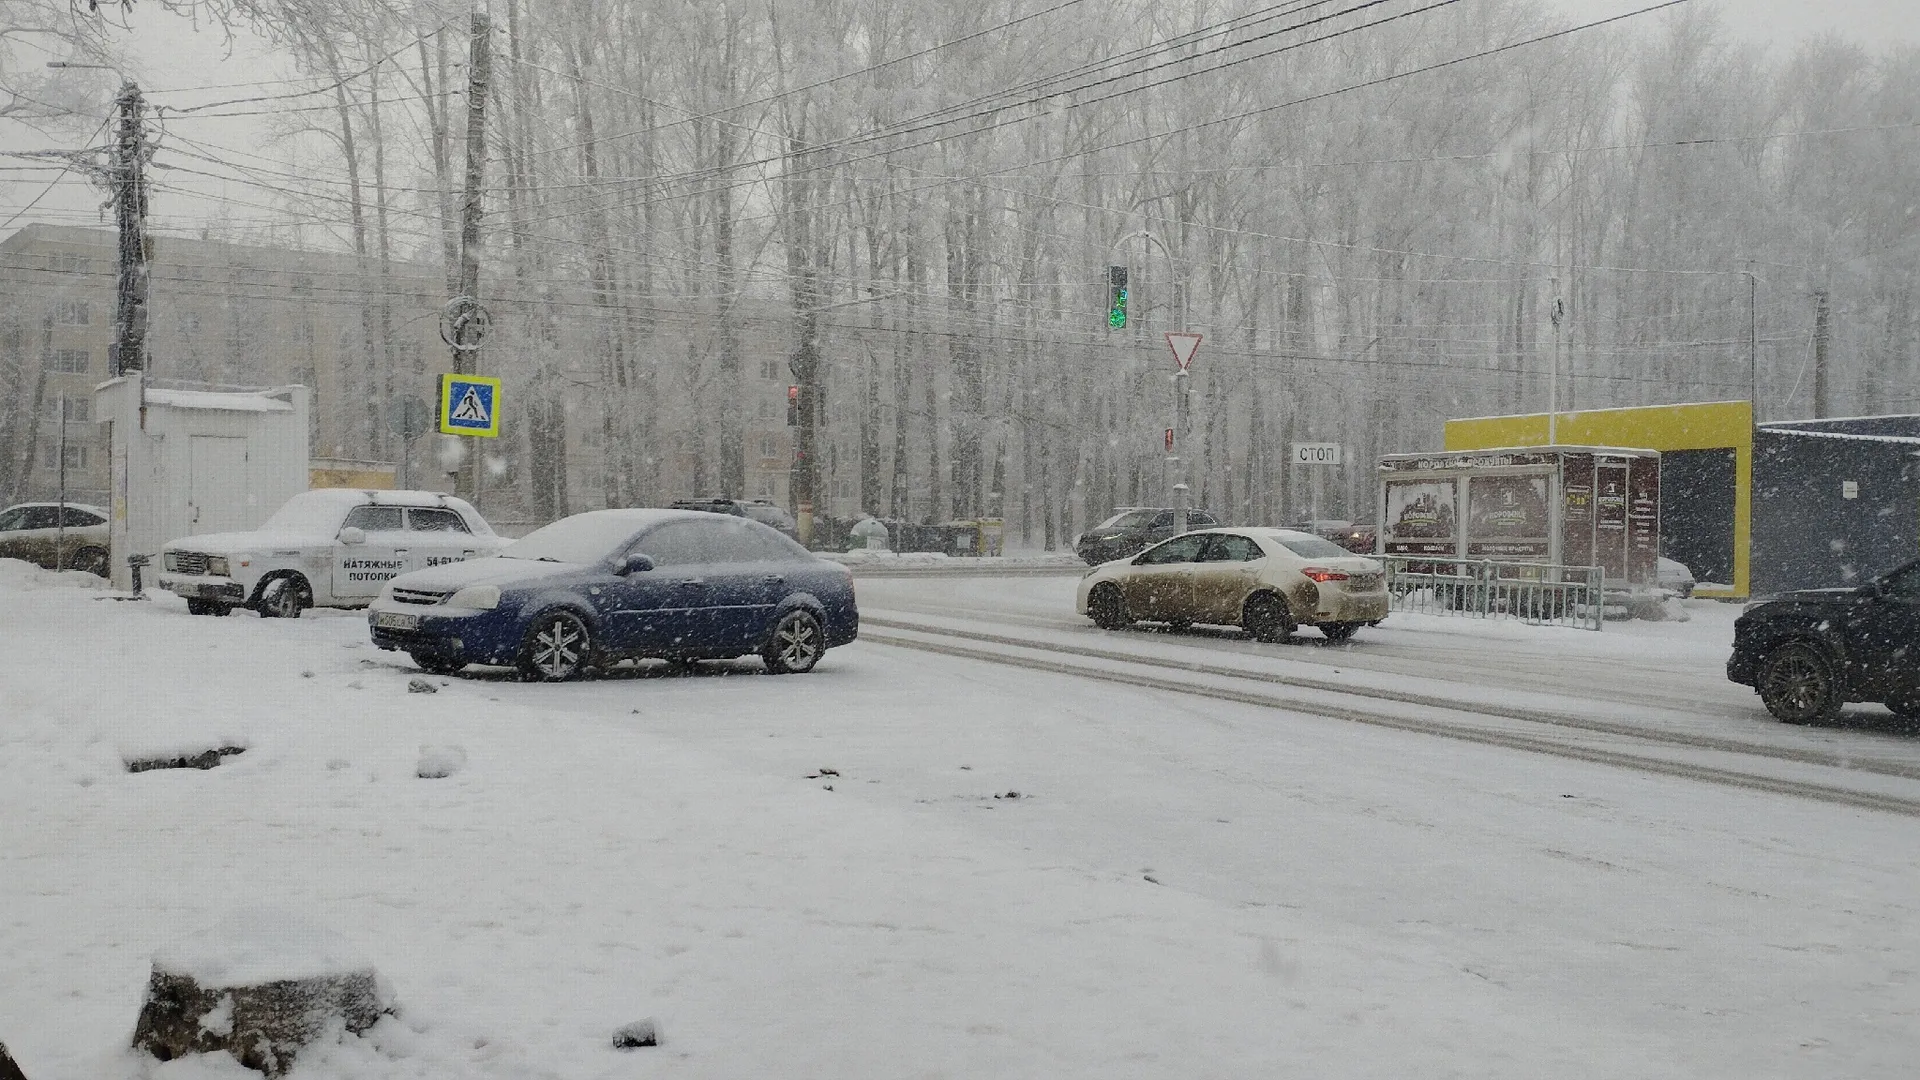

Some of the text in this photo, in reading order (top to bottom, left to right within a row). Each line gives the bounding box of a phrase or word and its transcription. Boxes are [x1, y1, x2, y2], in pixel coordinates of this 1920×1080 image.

[1300, 447, 1334, 461] СТОП
[343, 559, 403, 569] НАТЯЖНЫЕ
[349, 572, 398, 581] ПОТОЛКИ
